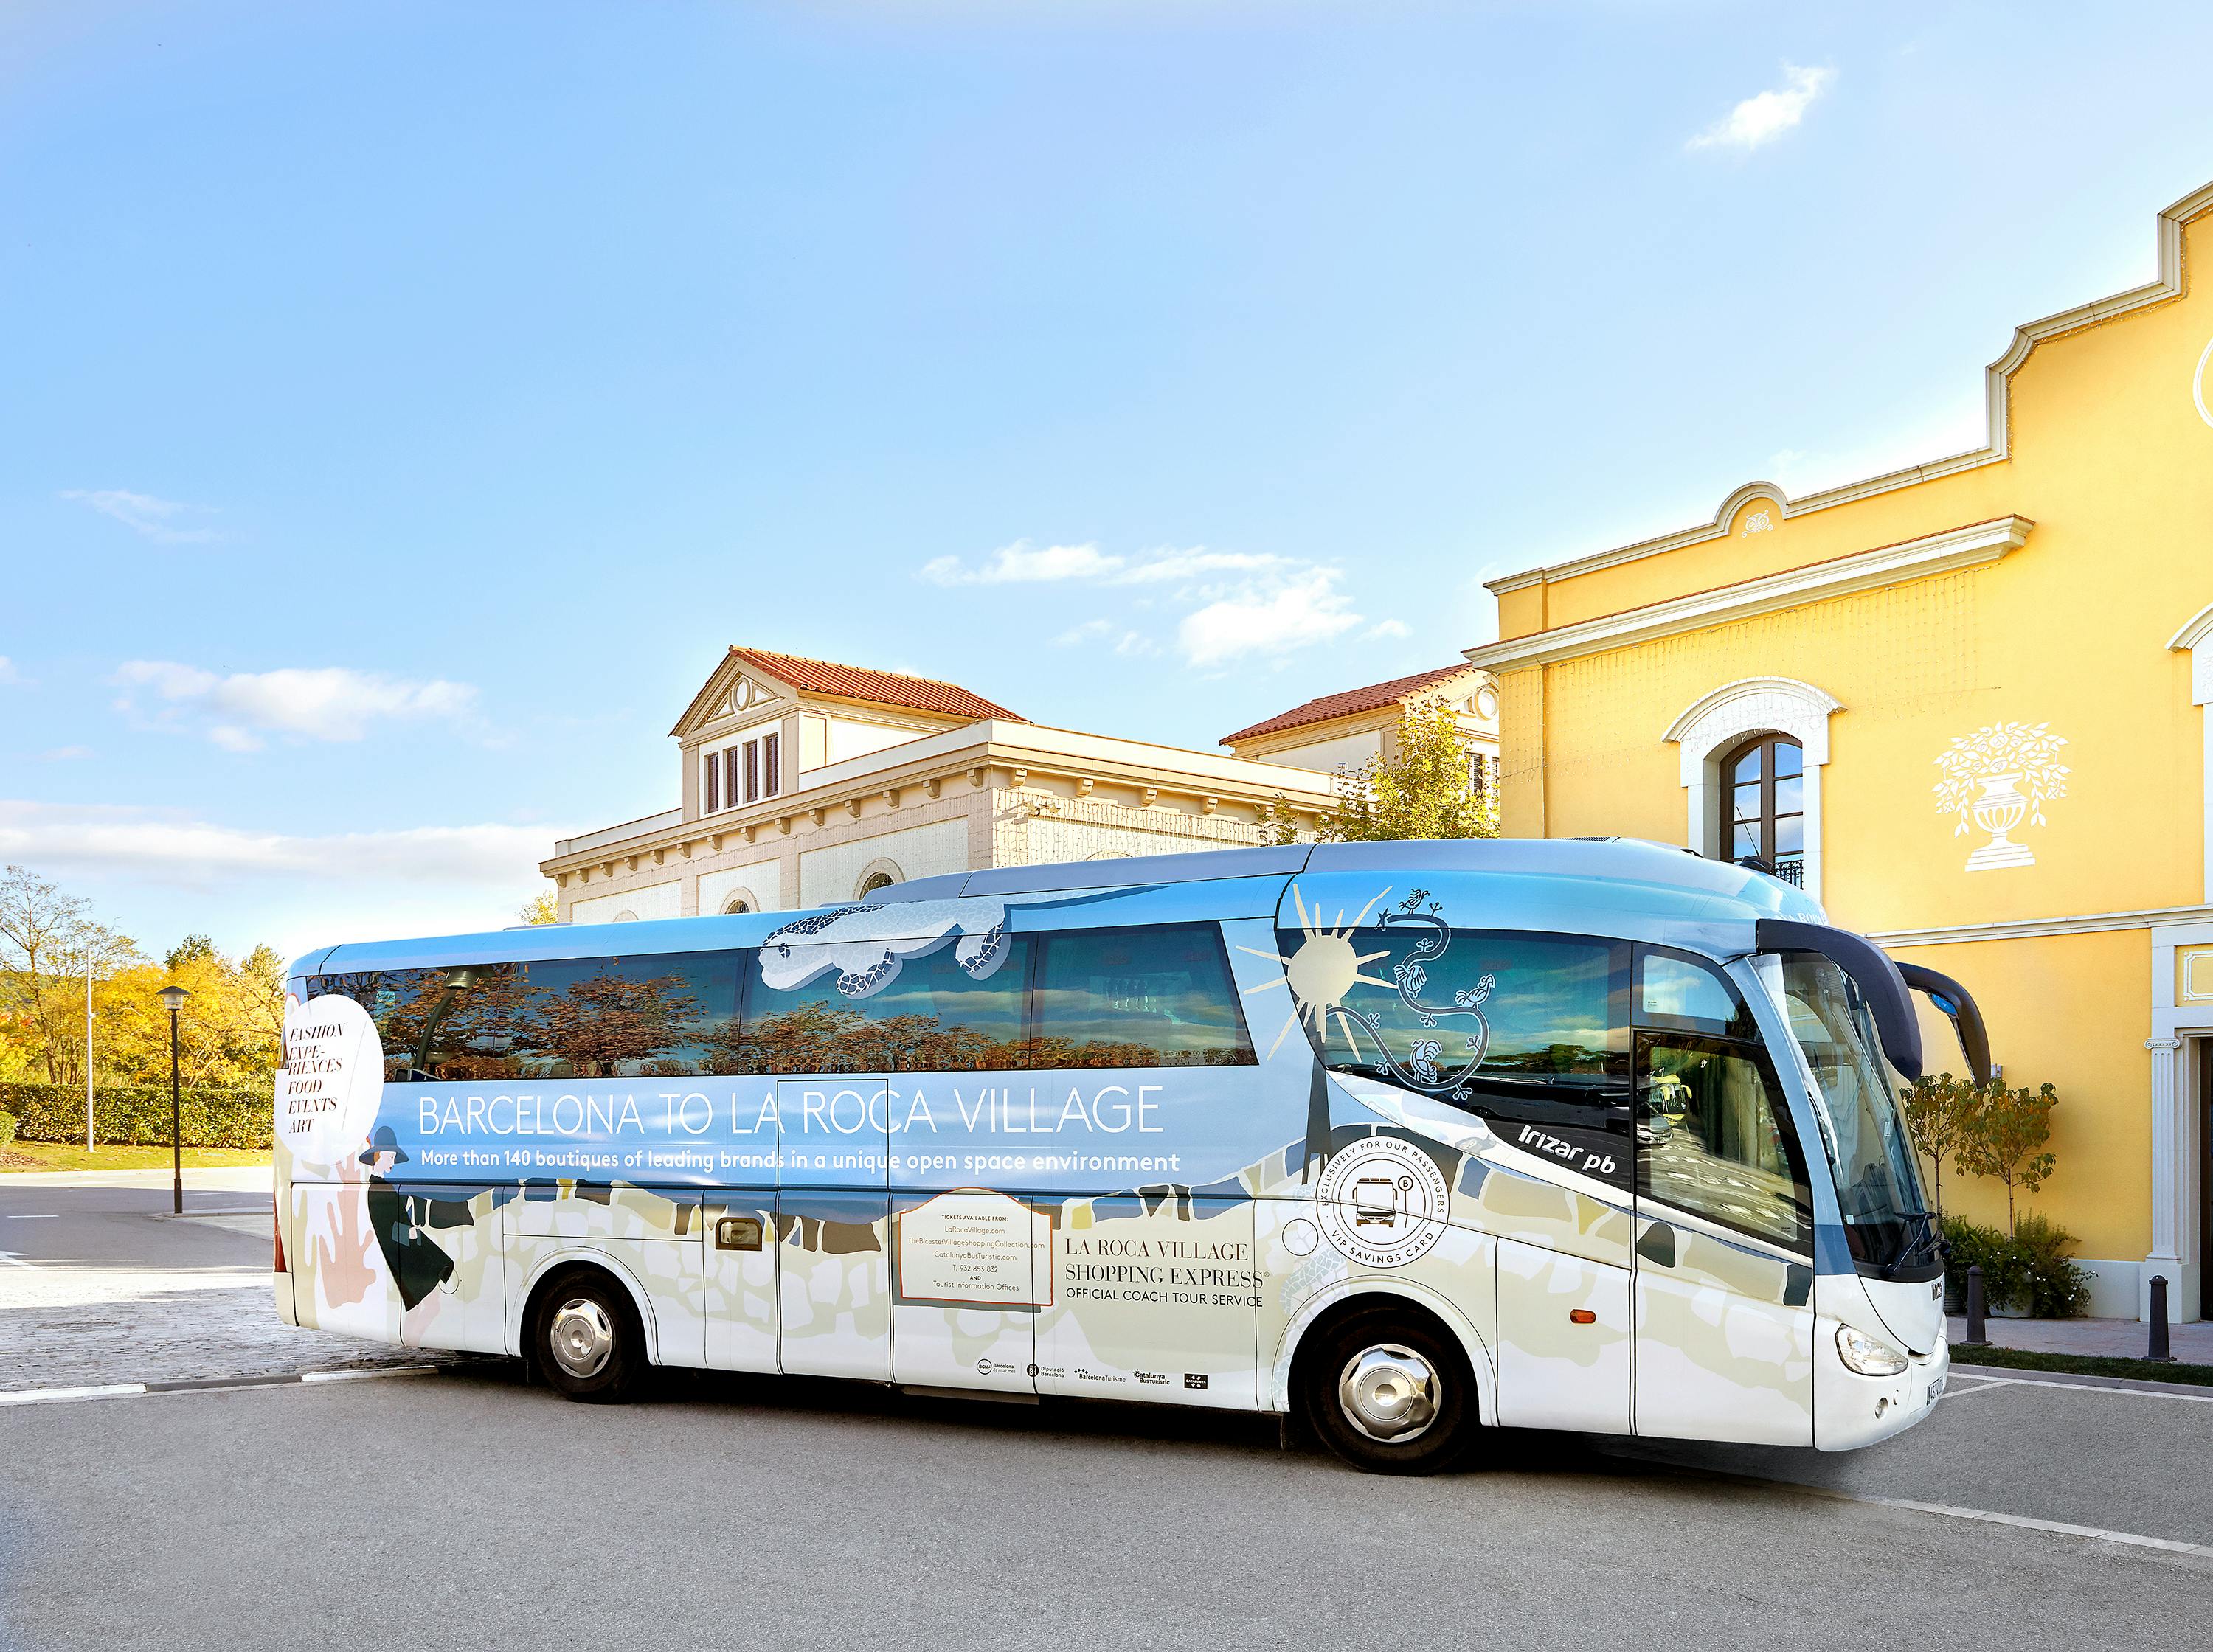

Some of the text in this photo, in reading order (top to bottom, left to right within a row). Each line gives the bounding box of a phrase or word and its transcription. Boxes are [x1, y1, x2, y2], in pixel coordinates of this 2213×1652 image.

[290, 1022, 347, 1042] FASHION
[288, 1045, 325, 1061] EXPE-
[288, 1058, 342, 1076] RIENCES
[288, 1079, 322, 1096] FOOD
[288, 1097, 338, 1114] EVENTS
[419, 1085, 1165, 1135] BARCELONA TO LA ROCA VILLAGE
[288, 1119, 316, 1134] ART
[1517, 1125, 1617, 1174] Irizar pb
[421, 1149, 1180, 1176] More than 140 boutiques of leading brands in a unique open space environment
[1320, 1141, 1444, 1213] EXCLUSIVELY FOR OUR PASSENGERS
[944, 1226, 1005, 1235] LaRocaVillage.com
[908, 1238, 1045, 1249] TheBicesterVillageShoppingCollection.com
[1064, 1238, 1248, 1261] LA ROCA VILLAGE
[1332, 1229, 1434, 1263] VIP SAVINGS CARD
[934, 1251, 1017, 1260] CatalunyaBusTuristic.com
[1065, 1263, 1164, 1285] SHOPPING
[933, 1280, 954, 1288] Tourist
[956, 1282, 994, 1290] Information
[1066, 1288, 1263, 1308] OFFICIAL COACH TOUR SERVICE
[1134, 1371, 1166, 1380] Catalunya
